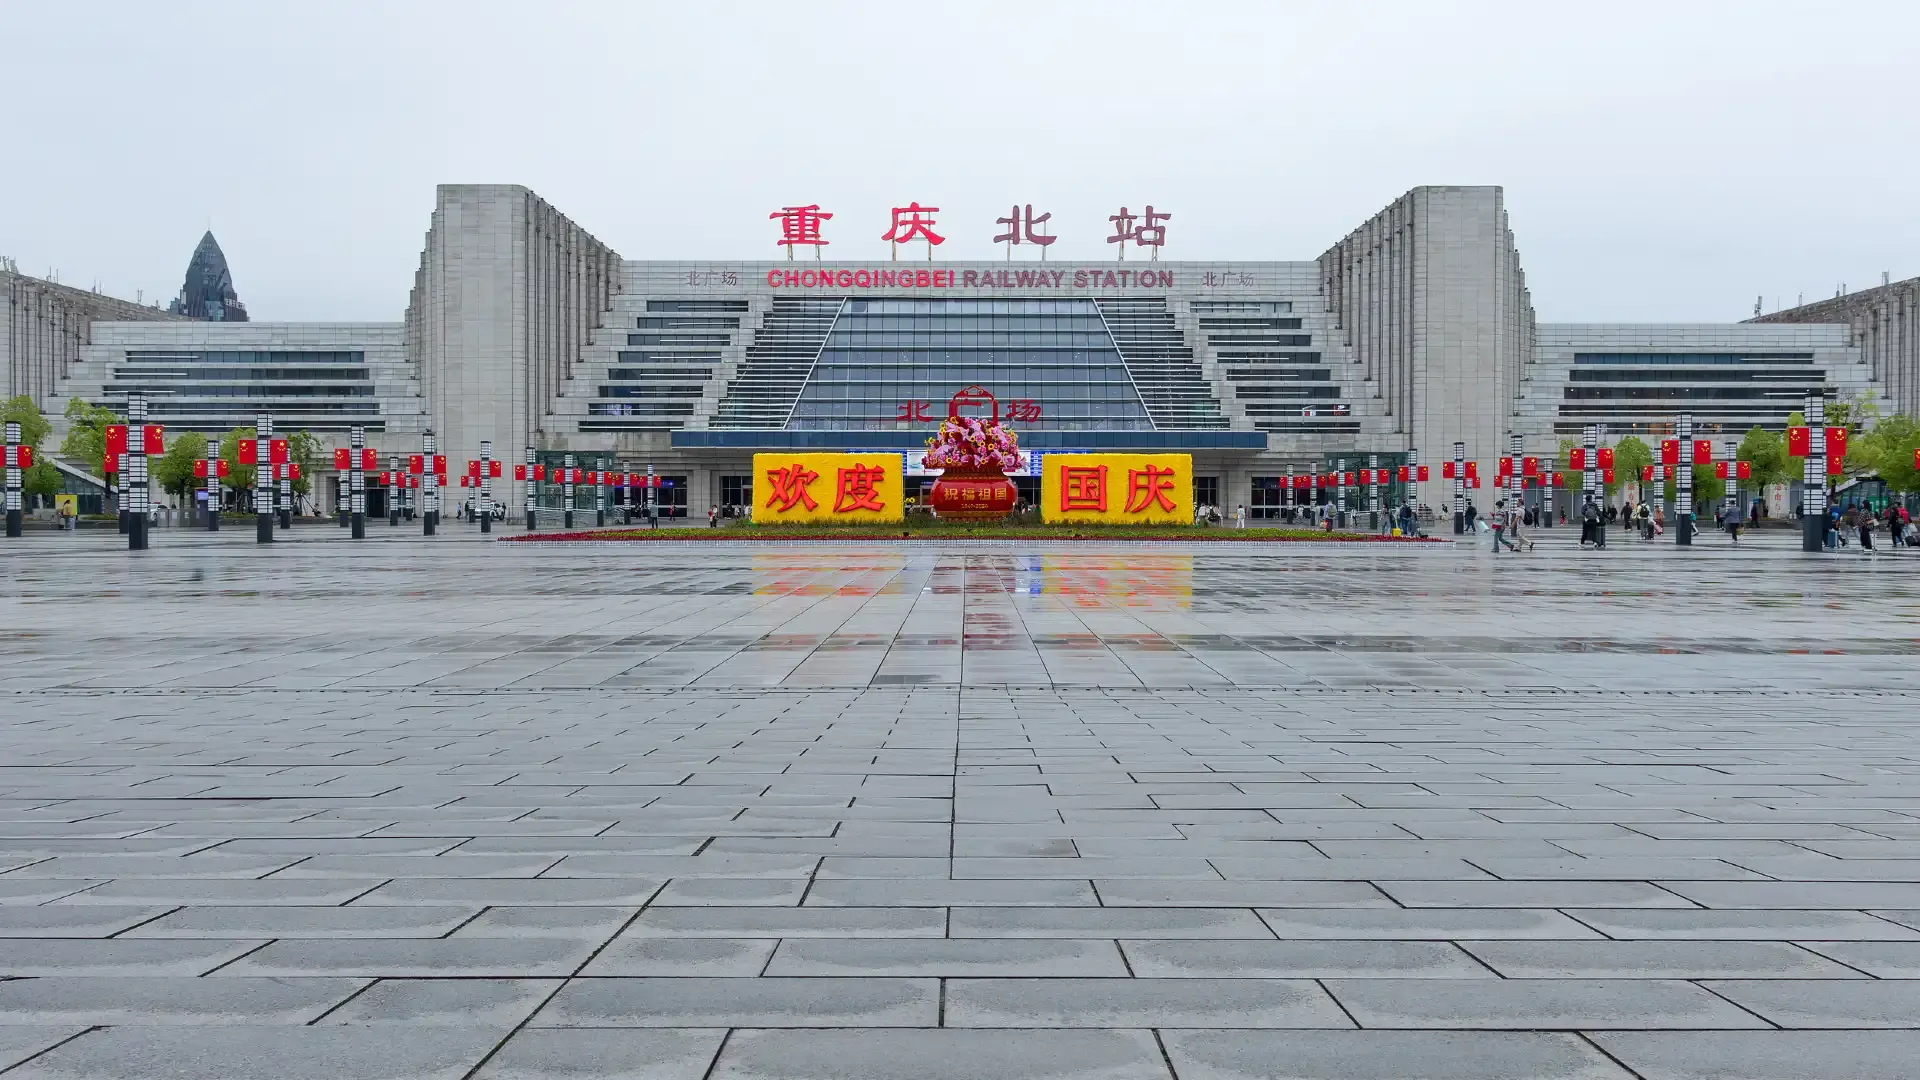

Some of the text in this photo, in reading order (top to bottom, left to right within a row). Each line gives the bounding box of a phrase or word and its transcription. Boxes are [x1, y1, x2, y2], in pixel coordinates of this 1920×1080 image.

[769, 201, 1171, 246] 重庆北站
[686, 270, 737, 287] 北广场
[767, 269, 1173, 288] CHONGQINGBEI RAILWAY STATION
[1201, 270, 1254, 287] 北广场
[766, 463, 885, 514] 欢度
[944, 487, 1007, 501] 祝福祖国
[1060, 464, 1177, 514] 国庆
